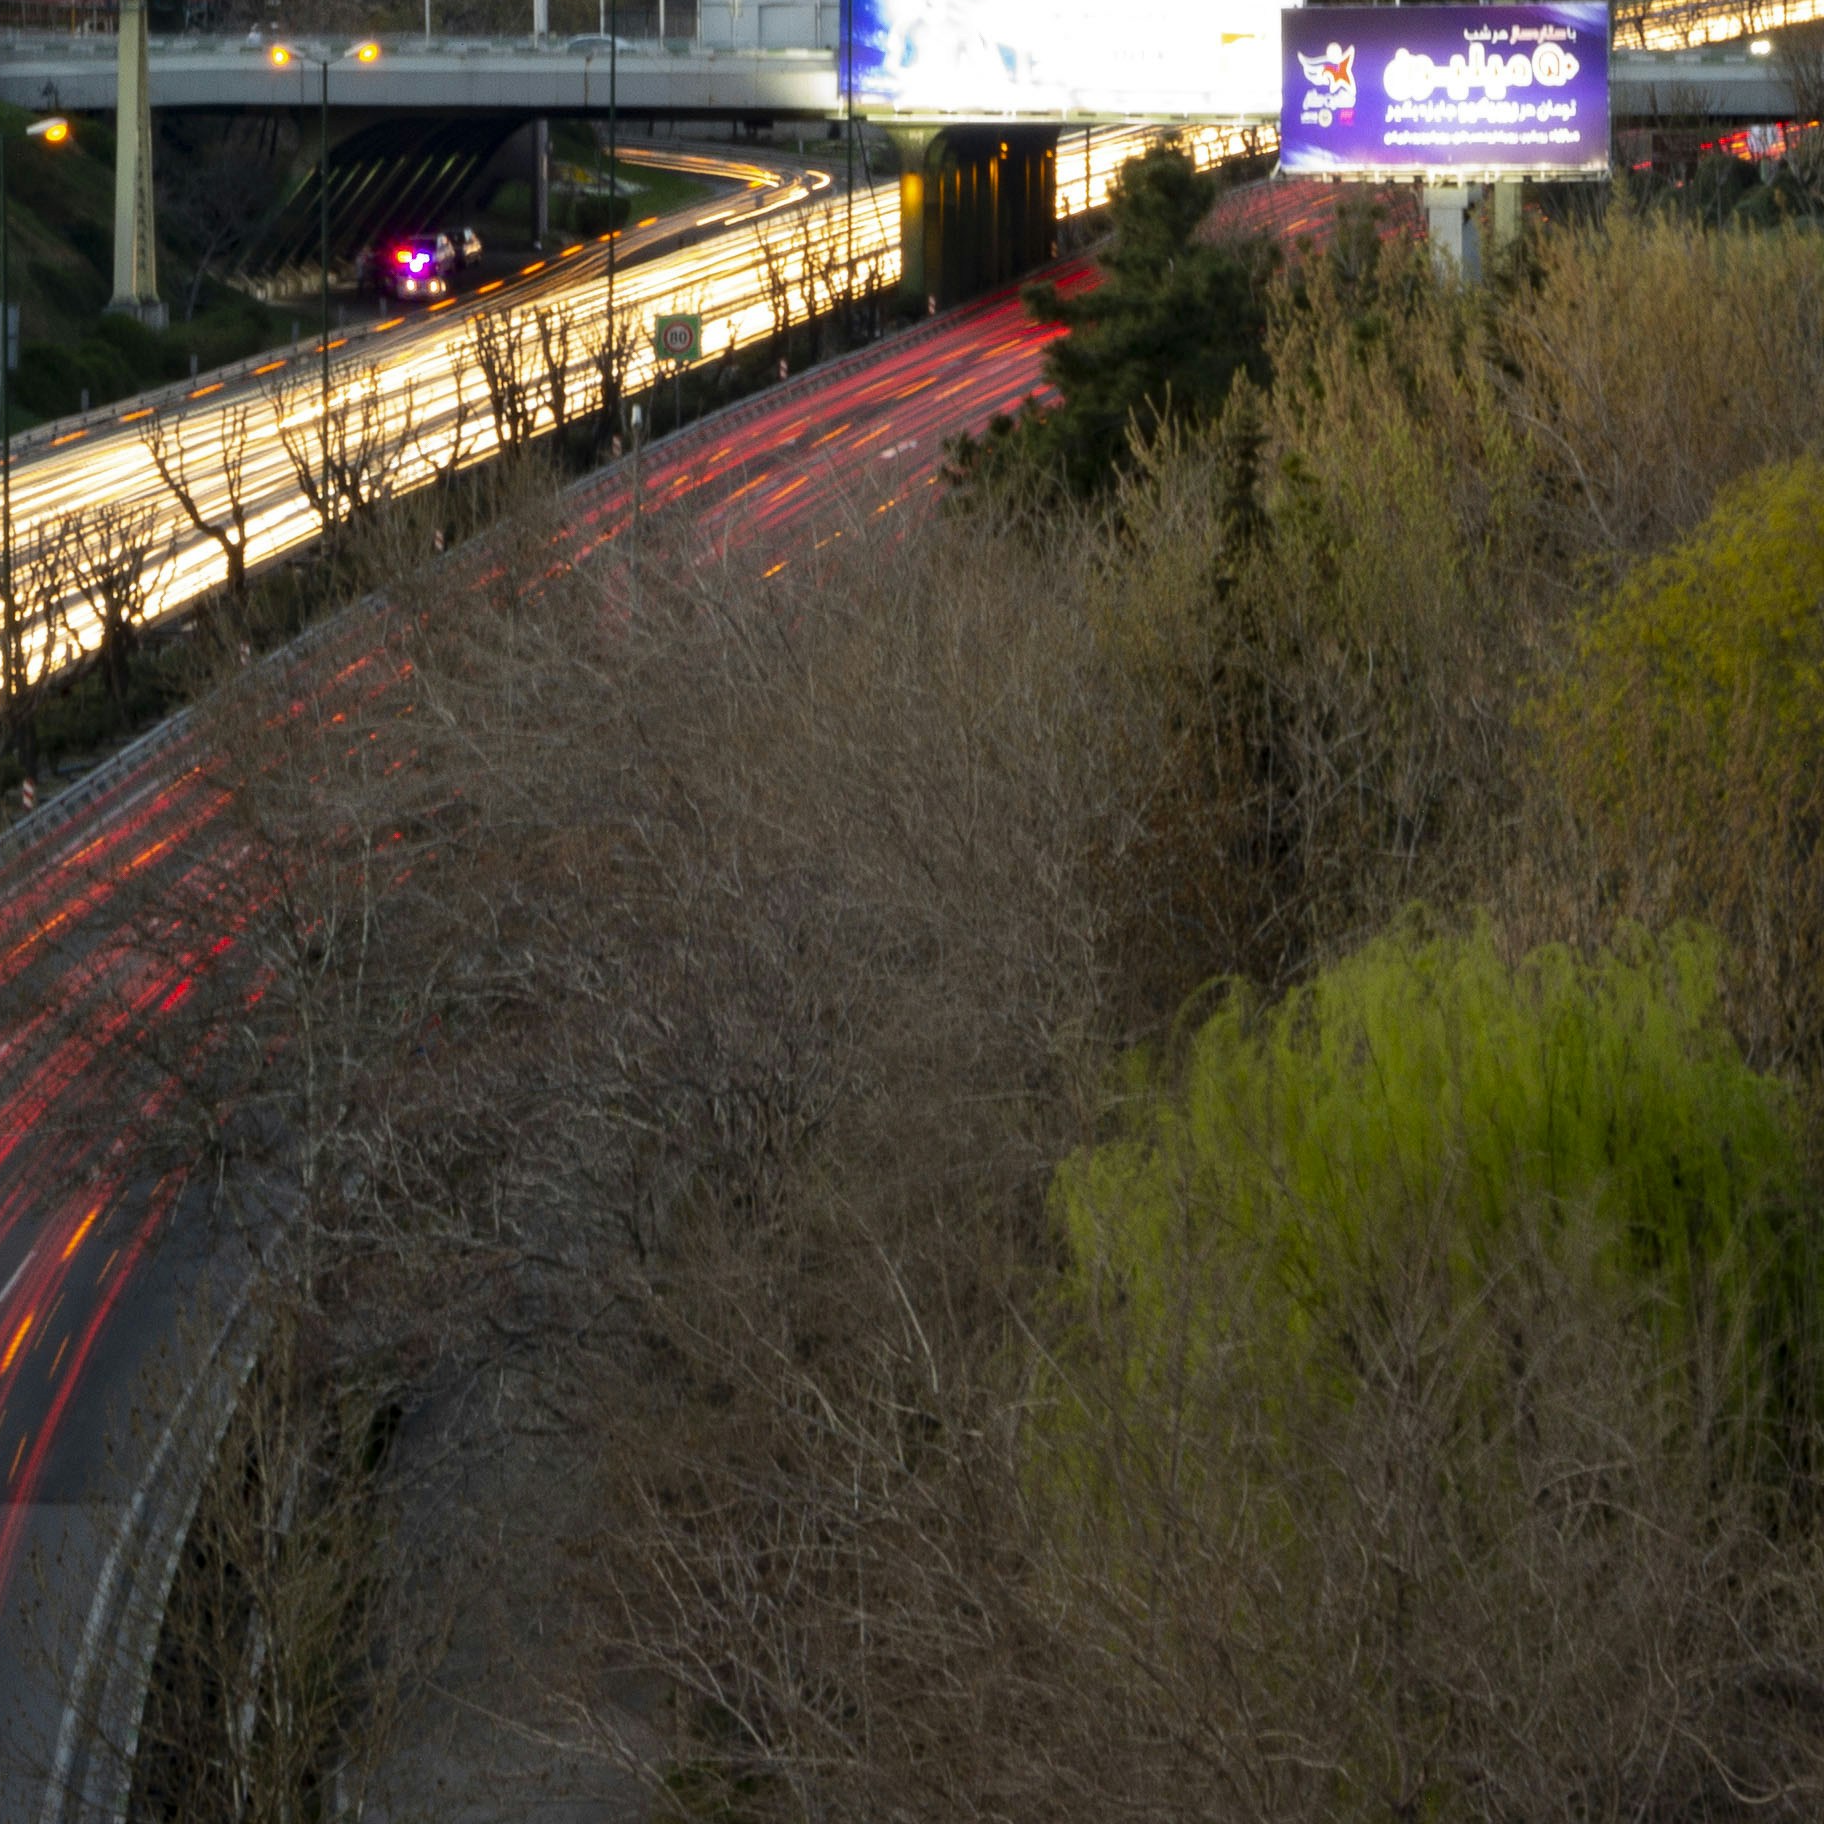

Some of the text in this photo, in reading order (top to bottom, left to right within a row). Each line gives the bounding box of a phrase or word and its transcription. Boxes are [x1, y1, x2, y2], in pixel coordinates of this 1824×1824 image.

[1463, 23, 1492, 43] شب
[1383, 42, 1533, 102] میلیون
[1537, 100, 1577, 122] تومان
[670, 330, 688, 344] 80
